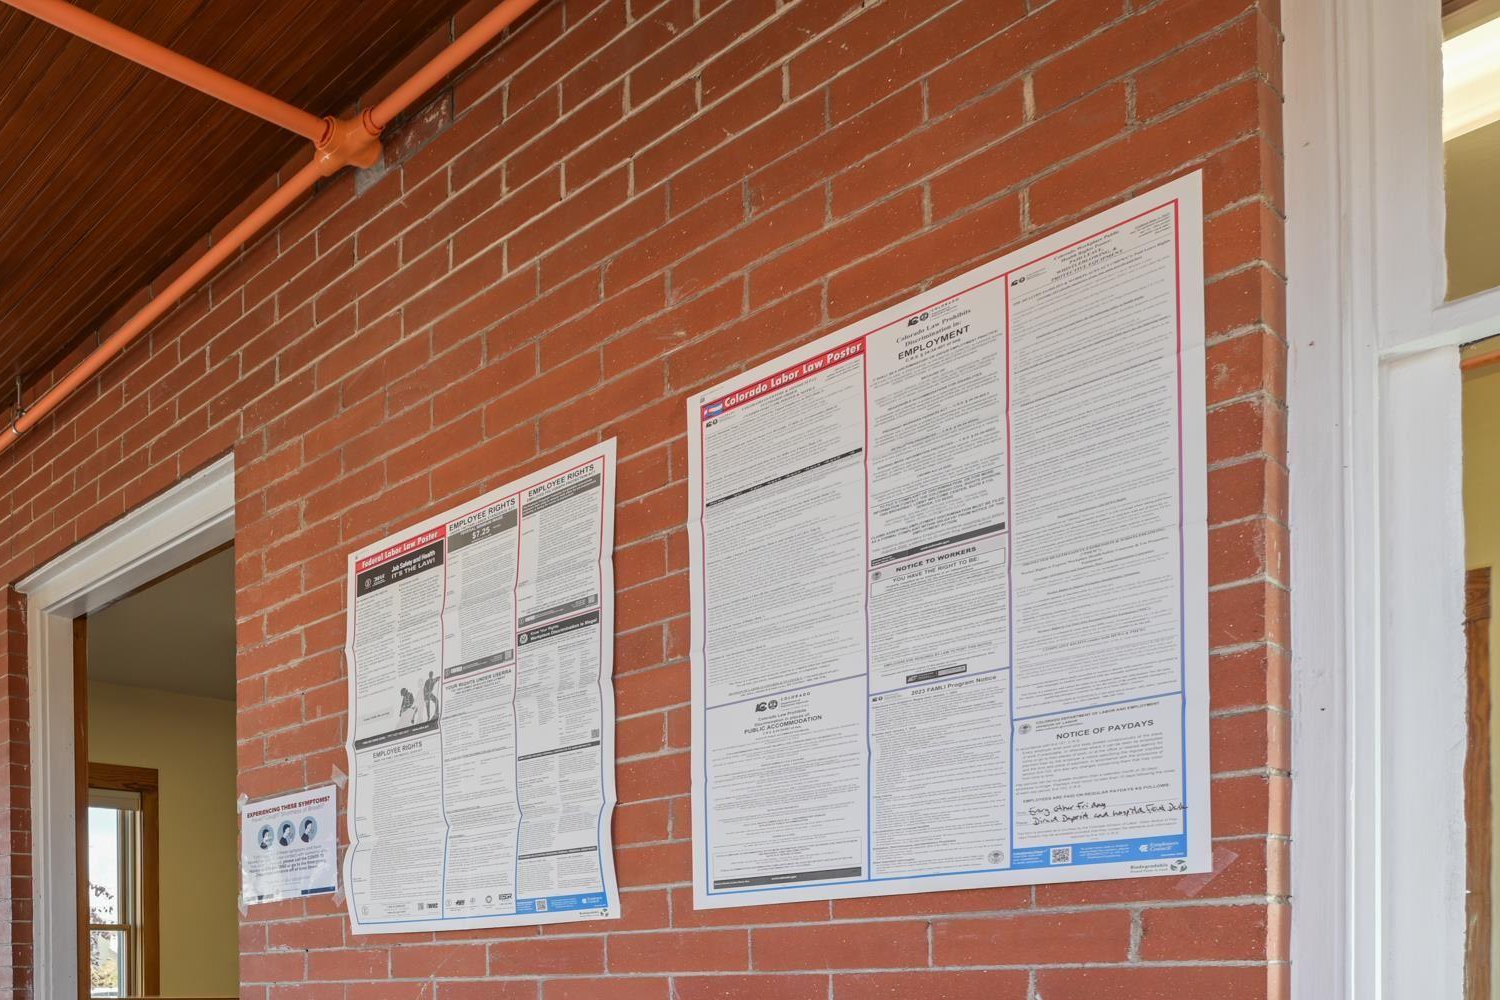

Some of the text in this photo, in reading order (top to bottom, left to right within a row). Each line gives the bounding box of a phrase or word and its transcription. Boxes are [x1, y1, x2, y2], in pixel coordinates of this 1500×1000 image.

[898, 325, 970, 360] EMPLOYMENT
[724, 342, 862, 407] Colorado Labor Law Poster
[528, 476, 565, 497] EMPLOYEE
[567, 464, 594, 480] RIGHTS
[449, 498, 516, 531] EMPLOYEE RIGHTS
[472, 526, 490, 539] $7.25
[362, 531, 438, 568] Federal Labor Law Poster
[896, 561, 923, 572] NOTICE
[938, 546, 977, 561] WORKERS
[405, 564, 417, 574] THE
[418, 557, 436, 569] LAW!
[907, 570, 922, 579] HAVE
[937, 562, 957, 571] RIGHT
[976, 675, 997, 683] Notice
[744, 715, 822, 735] PUBLIC ACCOMMODATION
[1056, 719, 1154, 740] NOTICE OF PAYDAYS
[373, 741, 422, 758] EMPLOYEE RIGHTS
[247, 806, 280, 818] EXPERIENCING
[281, 802, 297, 811] THESE
[298, 796, 330, 808] SYMPTOMS?
